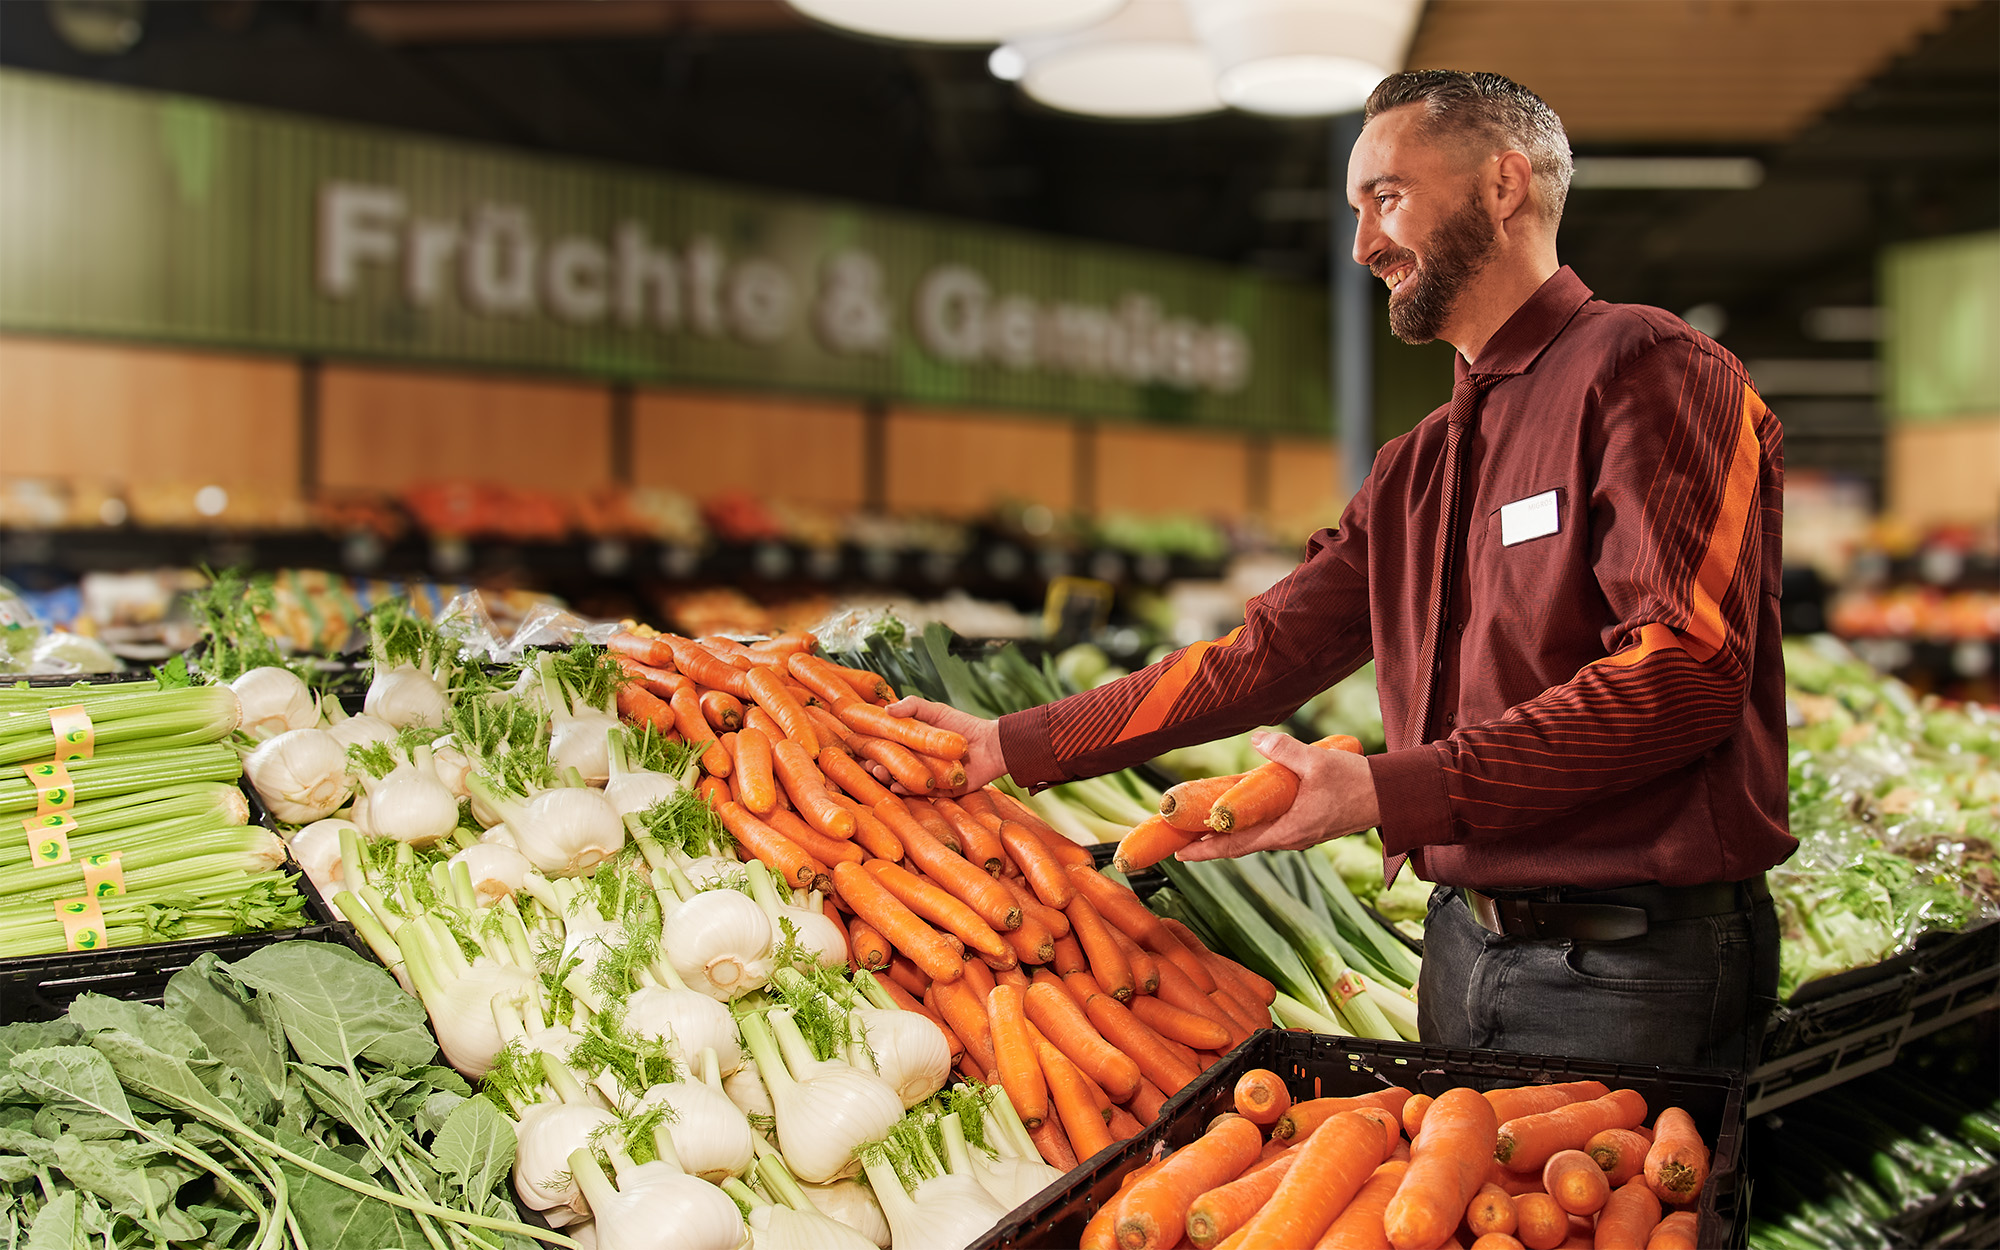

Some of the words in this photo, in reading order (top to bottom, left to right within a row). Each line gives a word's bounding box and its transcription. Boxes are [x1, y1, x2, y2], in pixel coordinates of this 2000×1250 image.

[317, 181, 793, 343] Früchte
[814, 250, 892, 354] &
[916, 262, 1250, 393] Gemüse
[1528, 498, 1553, 511] MIGROS
